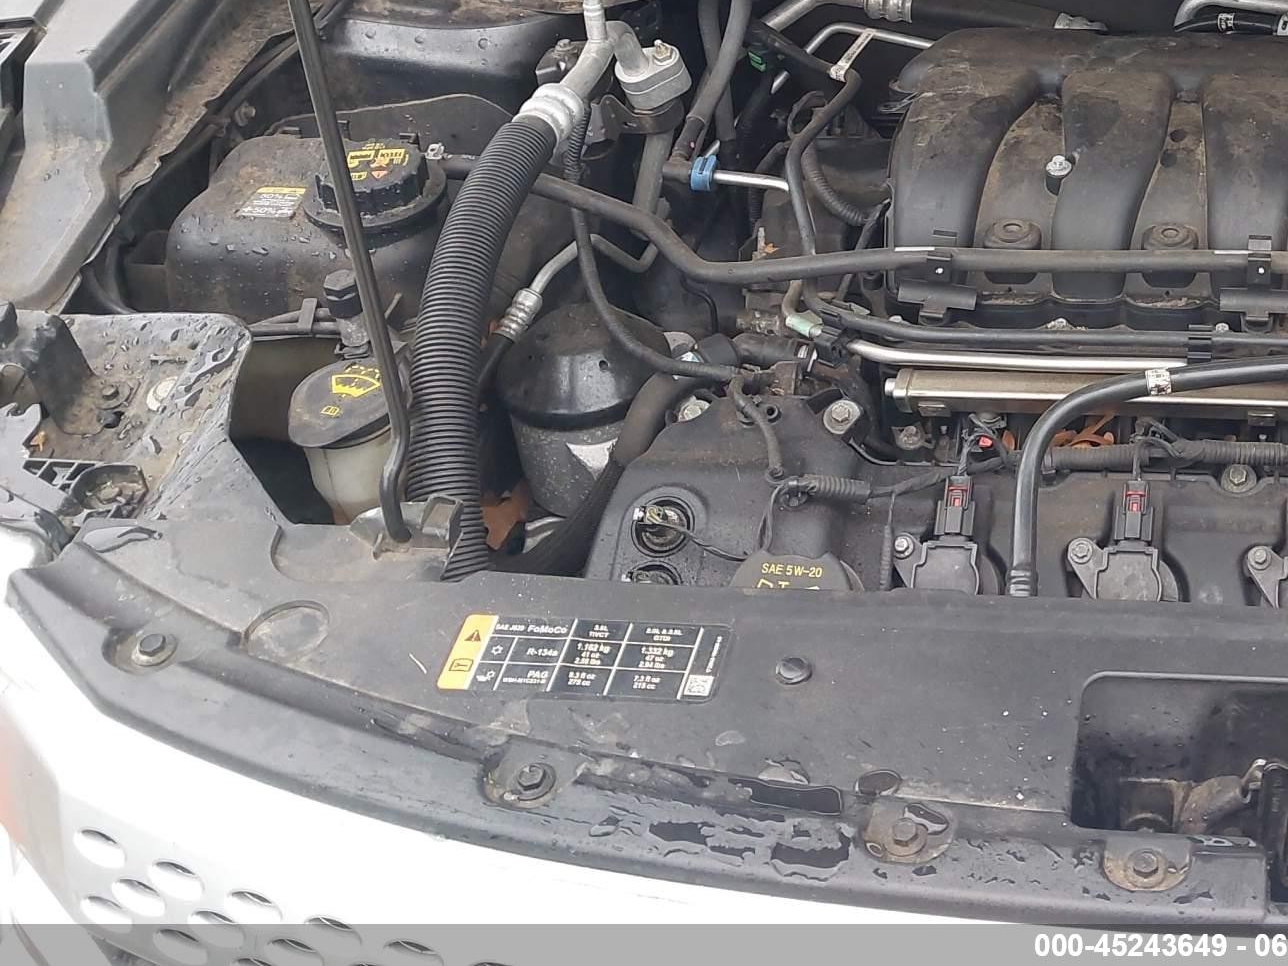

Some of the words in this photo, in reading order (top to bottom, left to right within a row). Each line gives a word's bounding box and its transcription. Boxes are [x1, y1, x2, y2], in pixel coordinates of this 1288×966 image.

[761, 563, 784, 575] SAE
[785, 564, 823, 578] 5W-20
[528, 625, 568, 634] FoMoCo
[527, 648, 558, 656] R-134a
[599, 644, 611, 654] kg
[664, 648, 674, 657] kg
[527, 670, 549, 678] PAG
